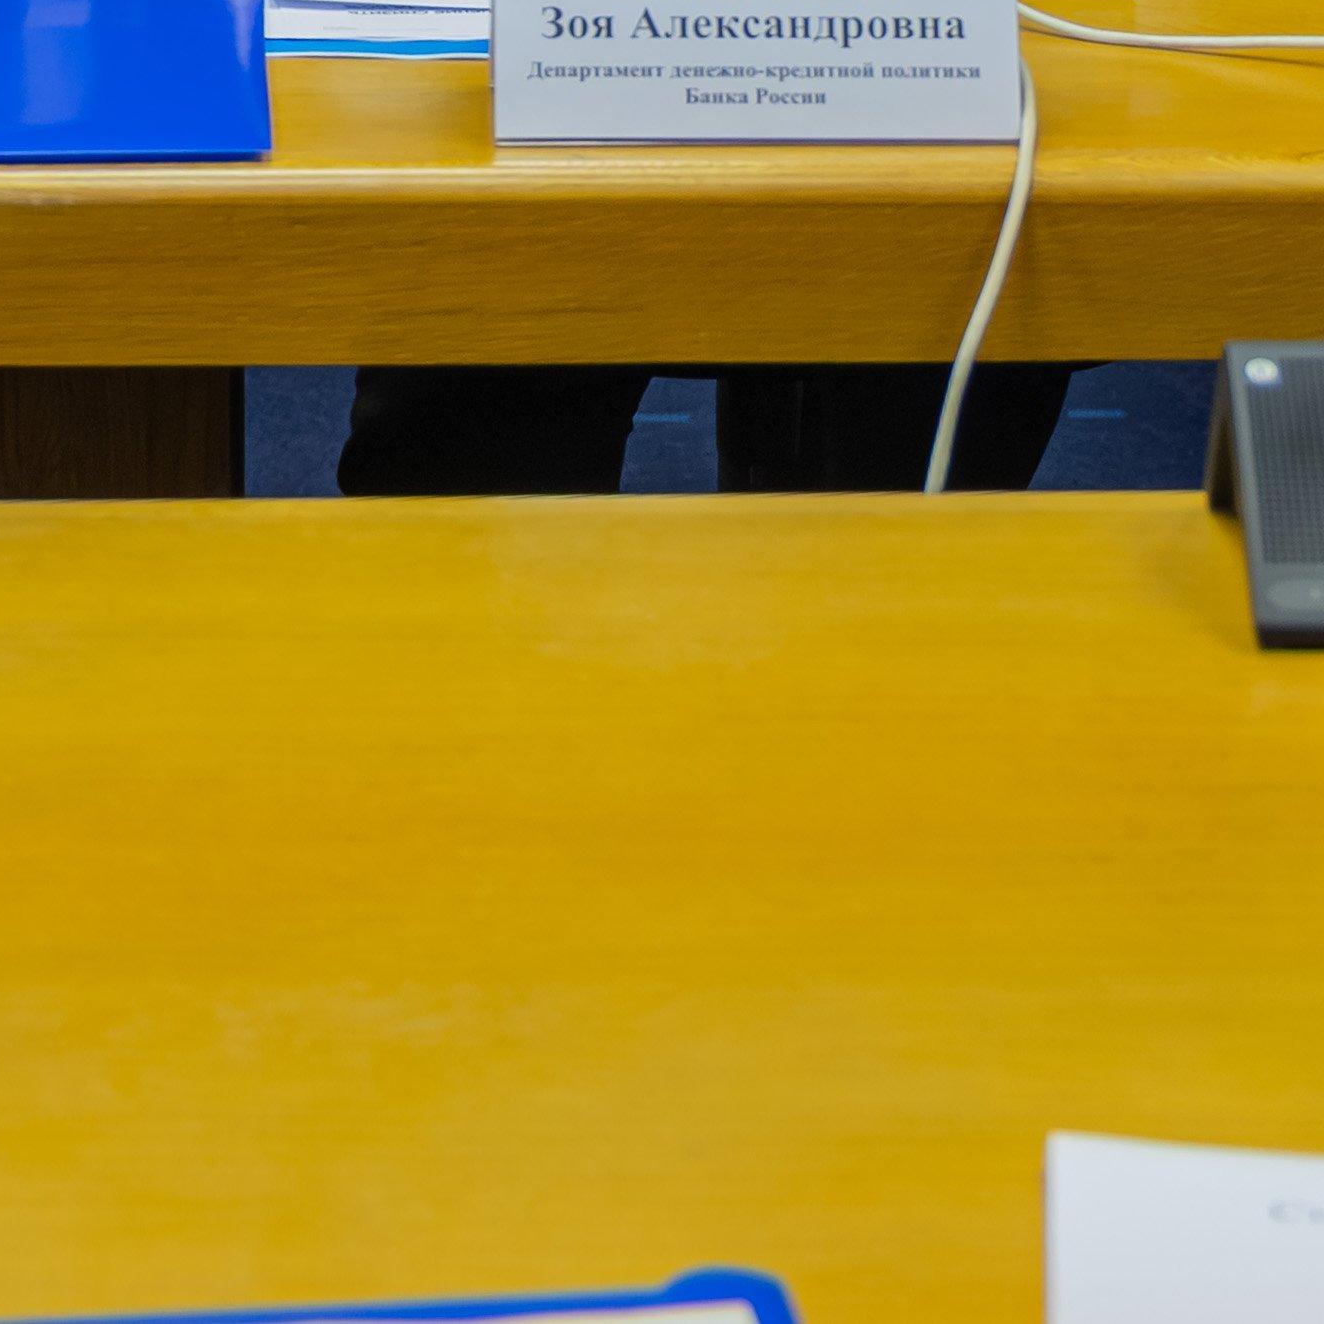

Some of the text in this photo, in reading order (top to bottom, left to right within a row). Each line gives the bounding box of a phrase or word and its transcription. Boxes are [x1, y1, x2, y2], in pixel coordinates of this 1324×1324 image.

[541, 5, 966, 49] Зоя Александровна
[526, 61, 982, 83] Департамент денежно-кредитной политики
[684, 86, 828, 106] Банка России
